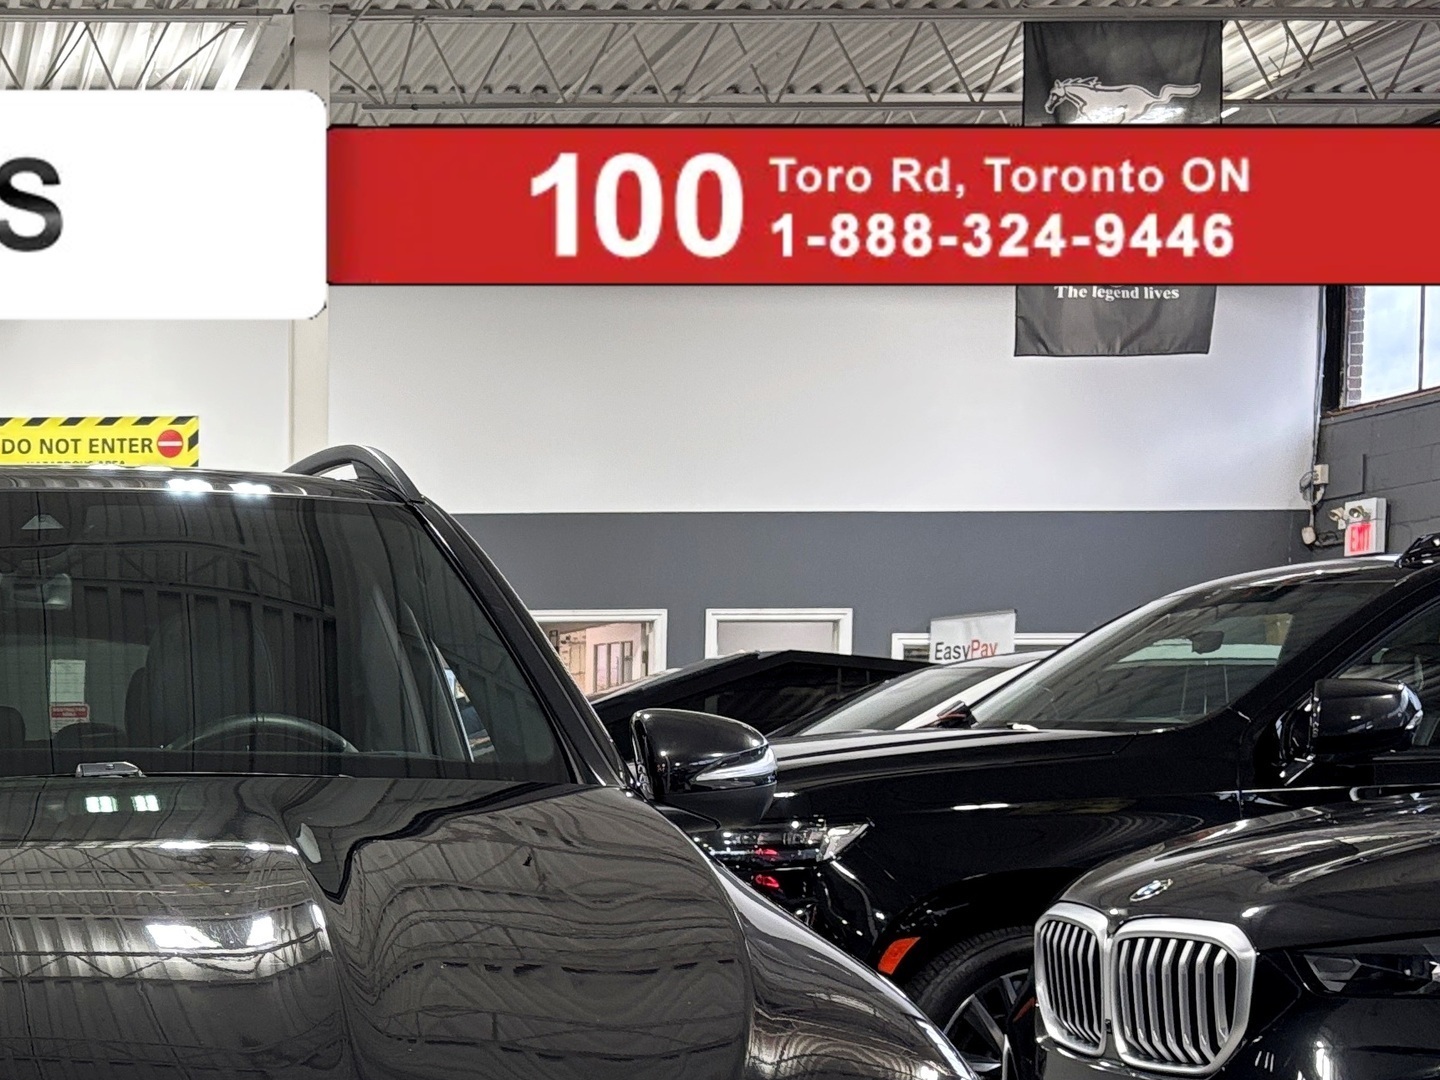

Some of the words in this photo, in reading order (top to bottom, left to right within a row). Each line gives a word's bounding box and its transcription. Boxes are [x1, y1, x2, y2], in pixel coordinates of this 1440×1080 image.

[1054, 285, 1088, 299] The
[1092, 286, 1140, 302] legend
[1144, 286, 1180, 300] lives
[1, 438, 31, 455] DO
[39, 438, 82, 455] NOT
[88, 437, 154, 454] ENTER
[1349, 522, 1372, 553] EXIT
[934, 638, 998, 661] EasyPay
